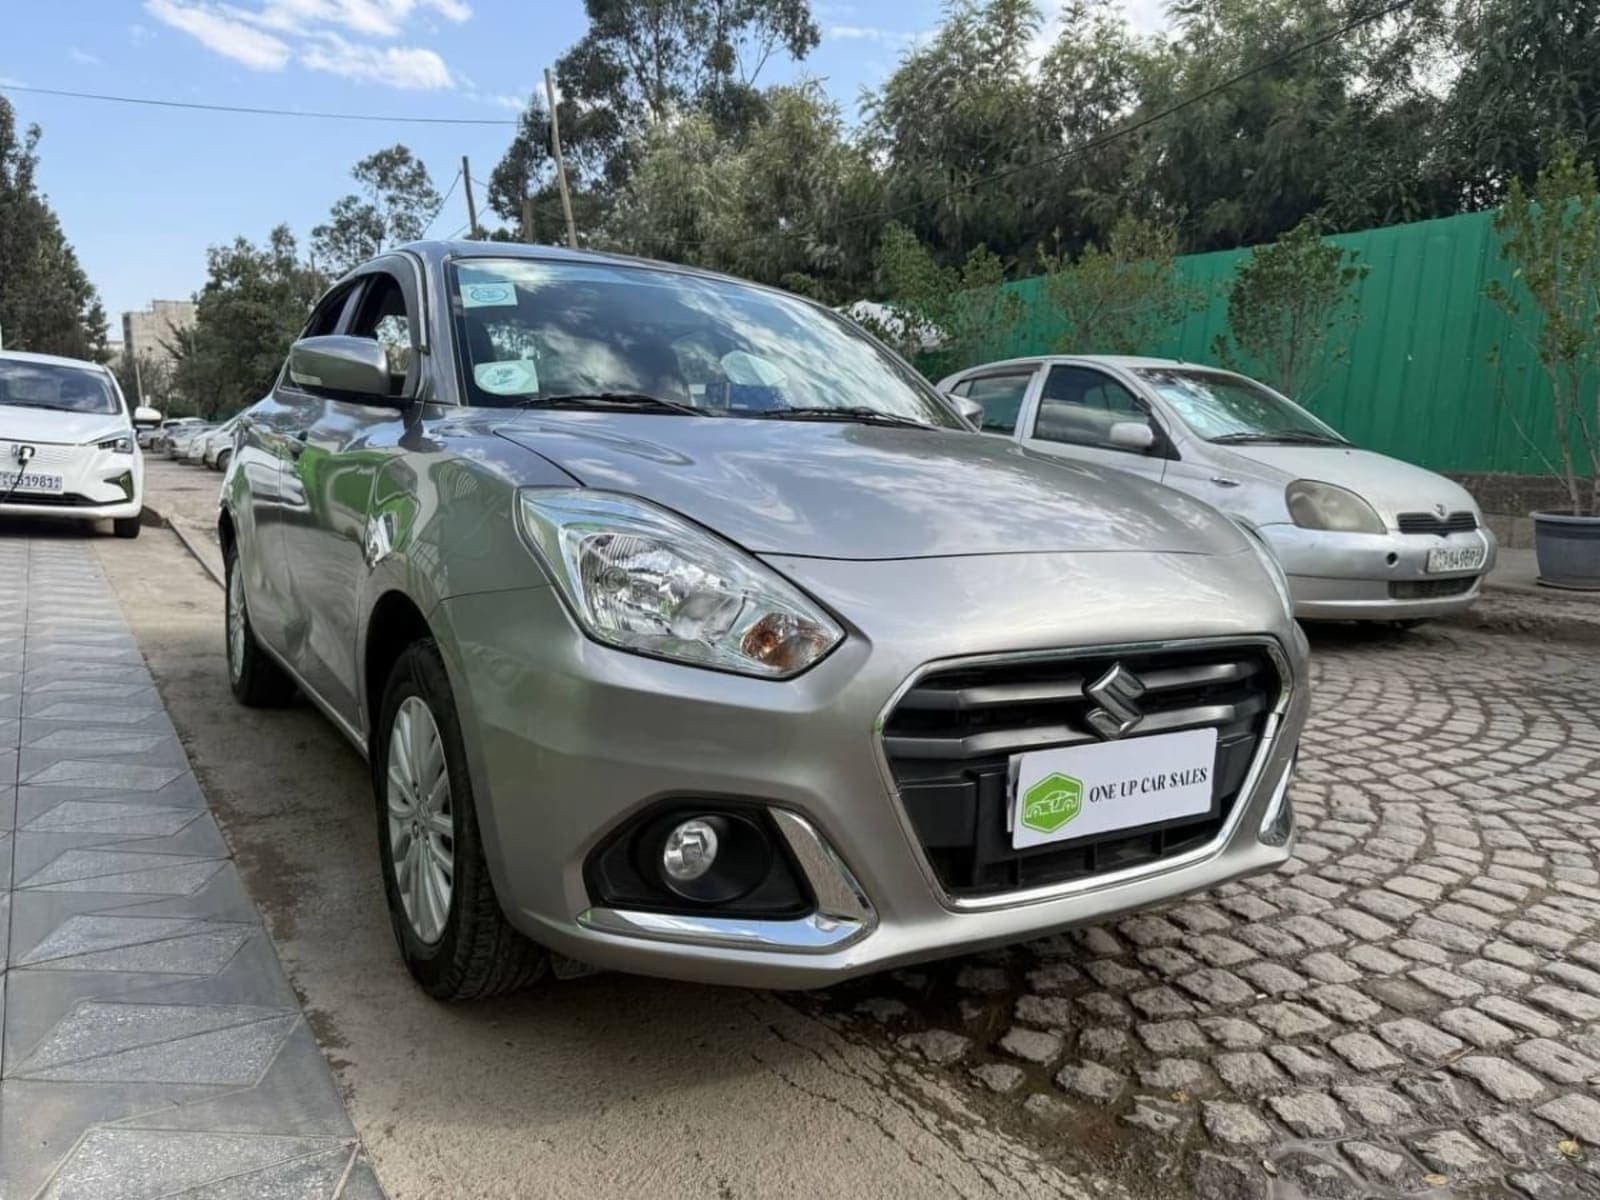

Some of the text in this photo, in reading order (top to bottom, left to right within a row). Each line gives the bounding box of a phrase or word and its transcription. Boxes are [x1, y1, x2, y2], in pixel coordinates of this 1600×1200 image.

[1089, 767, 1208, 803] ONE UP CAR SALES
